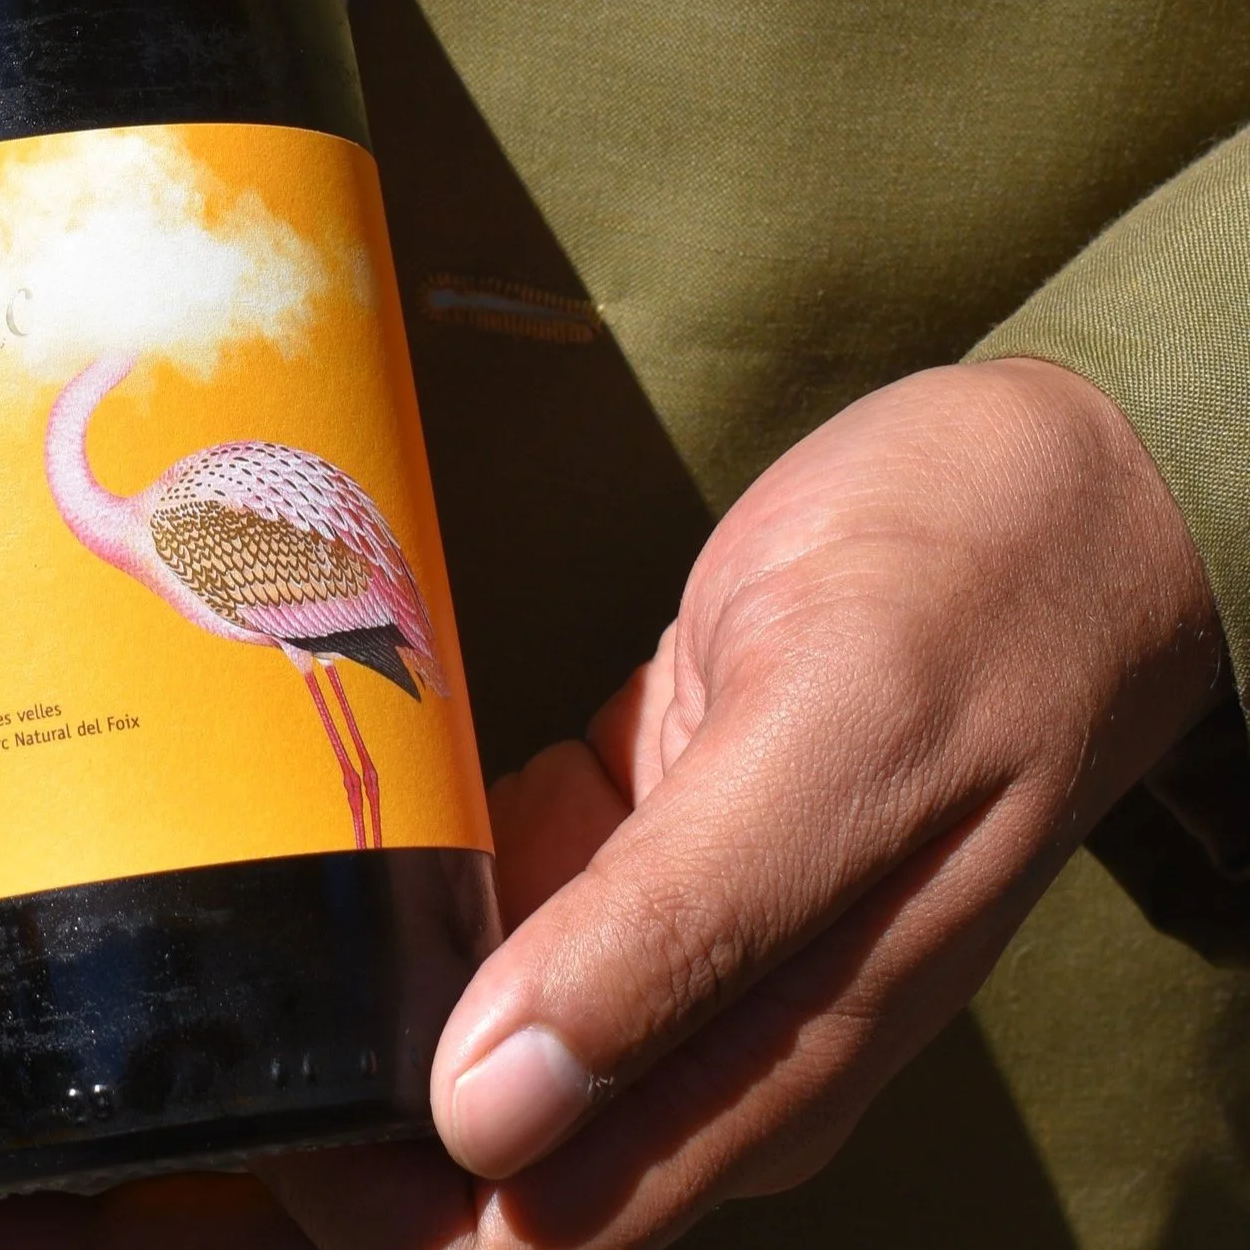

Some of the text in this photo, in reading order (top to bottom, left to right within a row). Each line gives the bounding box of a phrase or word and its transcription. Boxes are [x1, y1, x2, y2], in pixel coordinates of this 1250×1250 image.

[17, 702, 62, 723] velles
[15, 723, 72, 748] Natural
[77, 720, 102, 737] del
[107, 714, 140, 731] Foix
